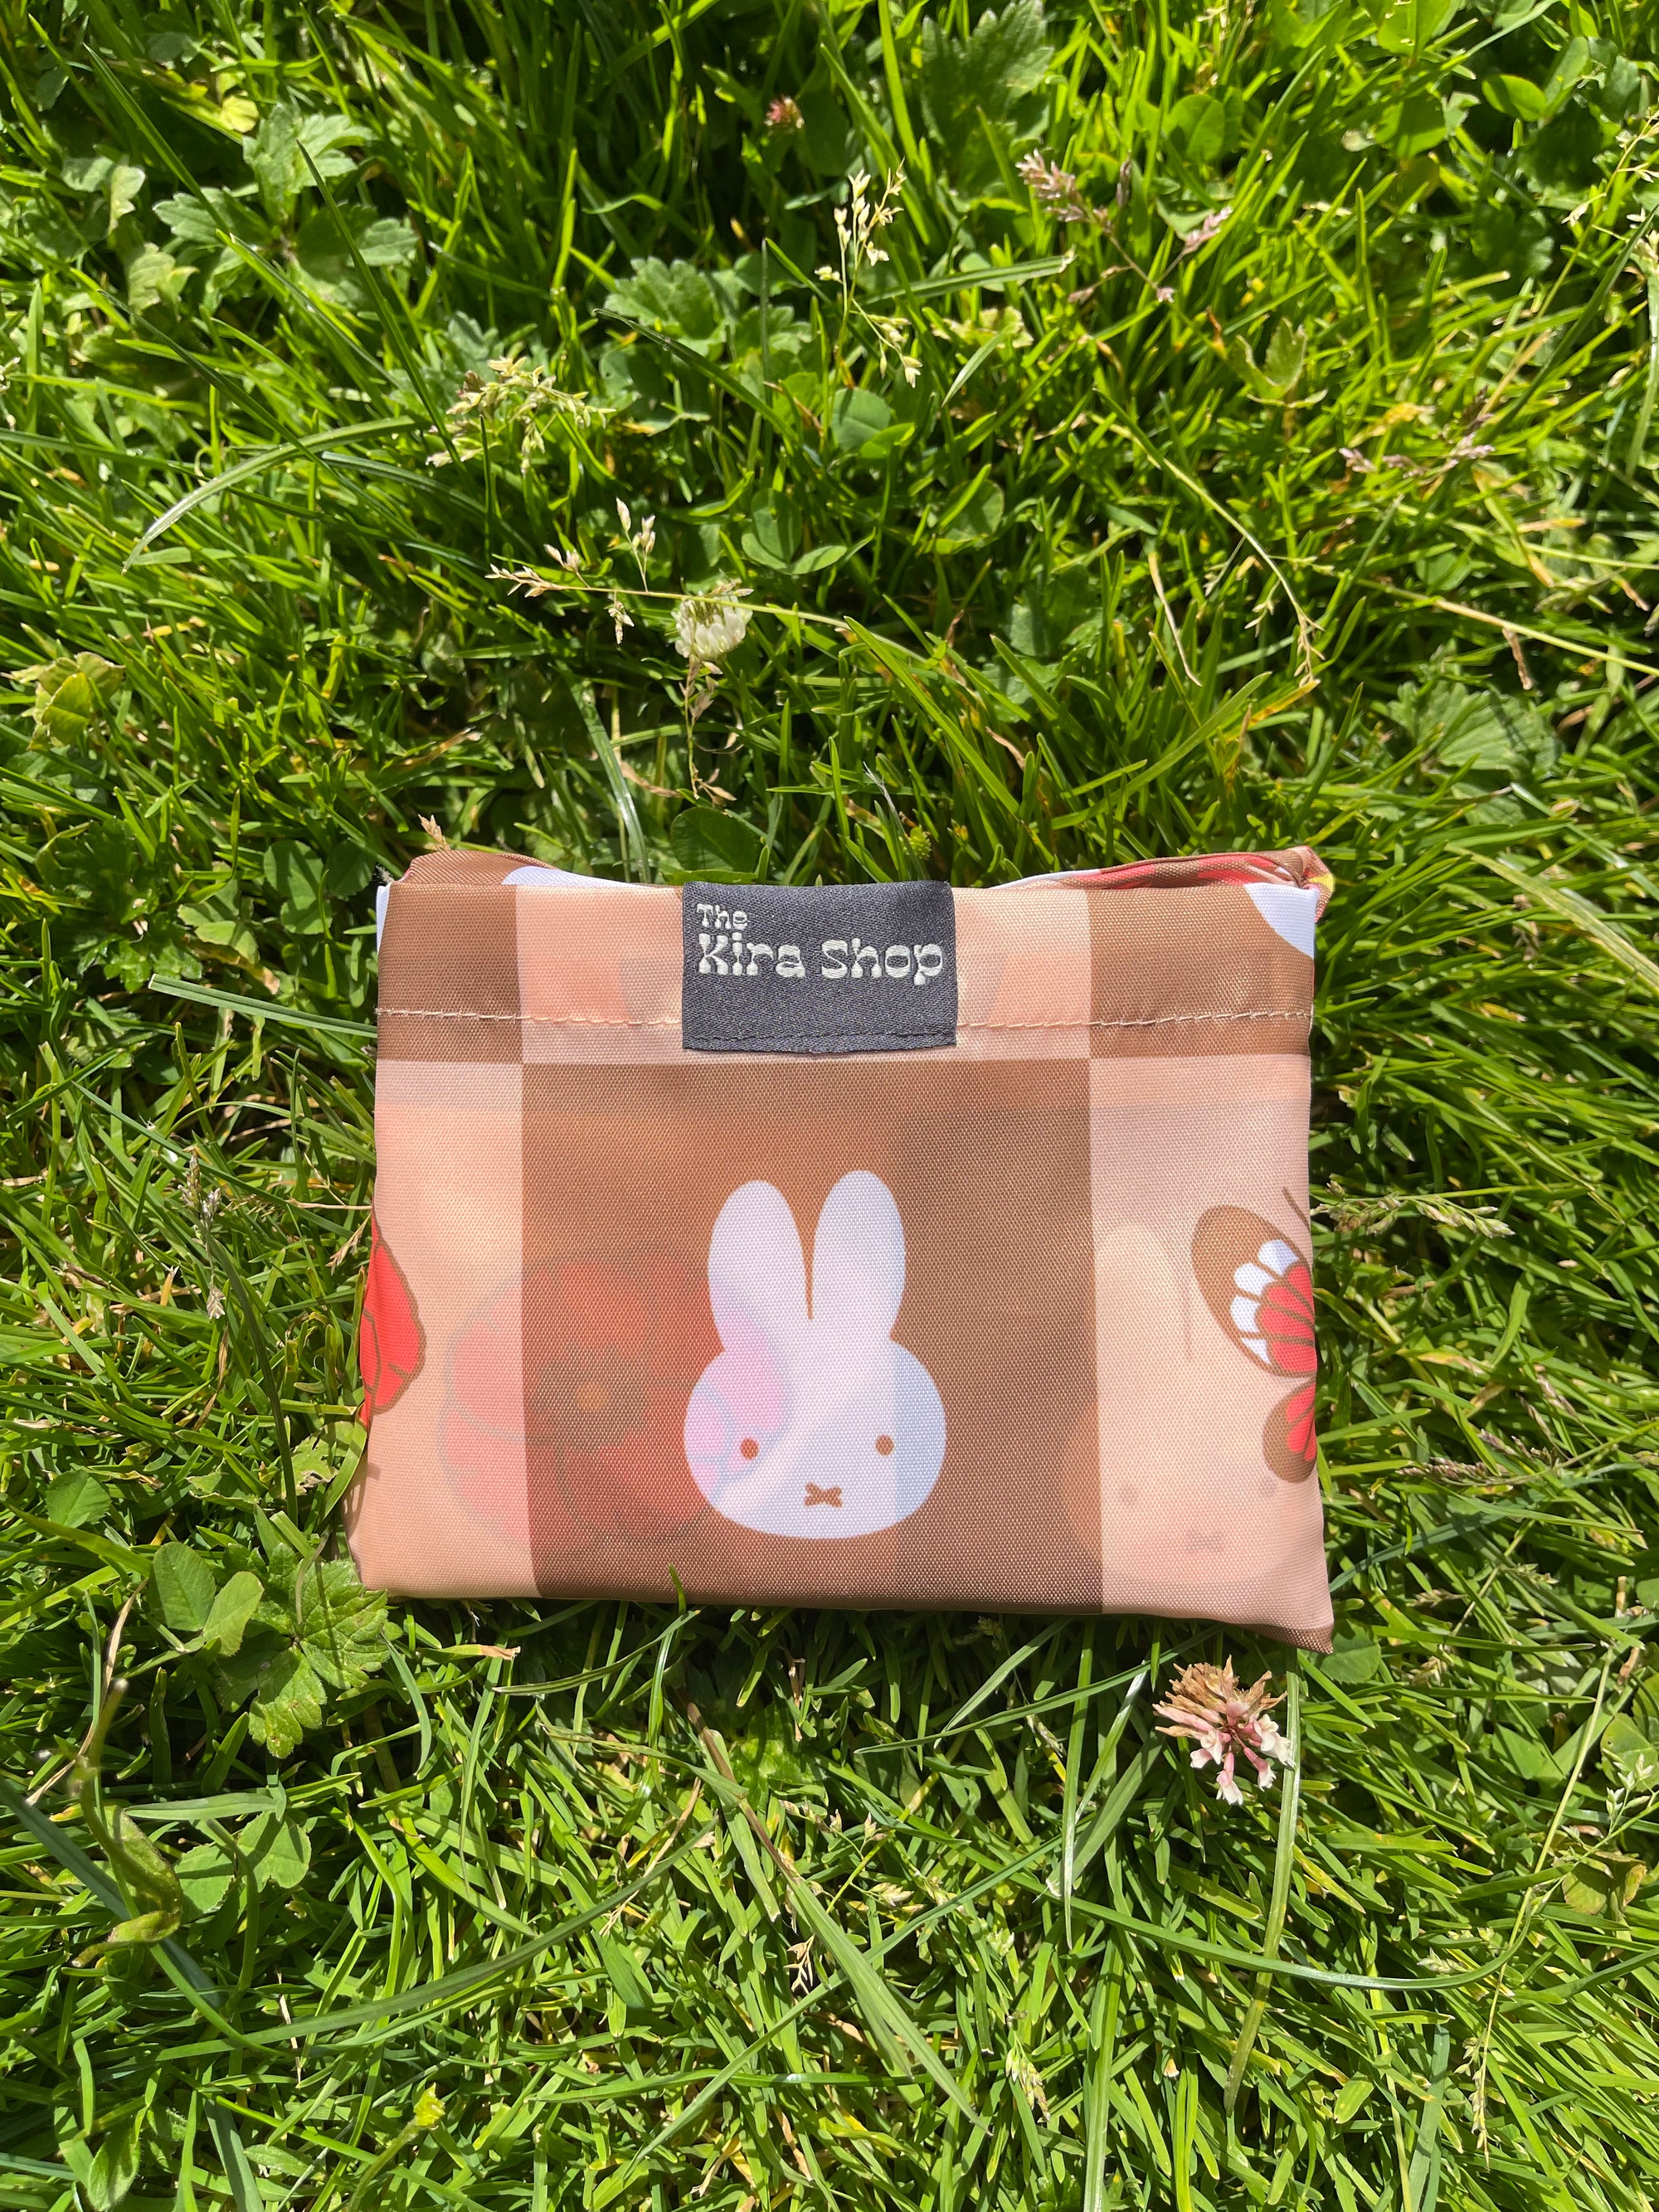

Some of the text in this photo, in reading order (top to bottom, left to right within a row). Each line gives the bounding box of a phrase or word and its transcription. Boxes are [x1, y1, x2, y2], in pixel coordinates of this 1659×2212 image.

[696, 902, 749, 931] The
[698, 931, 944, 986] Kira Shop
